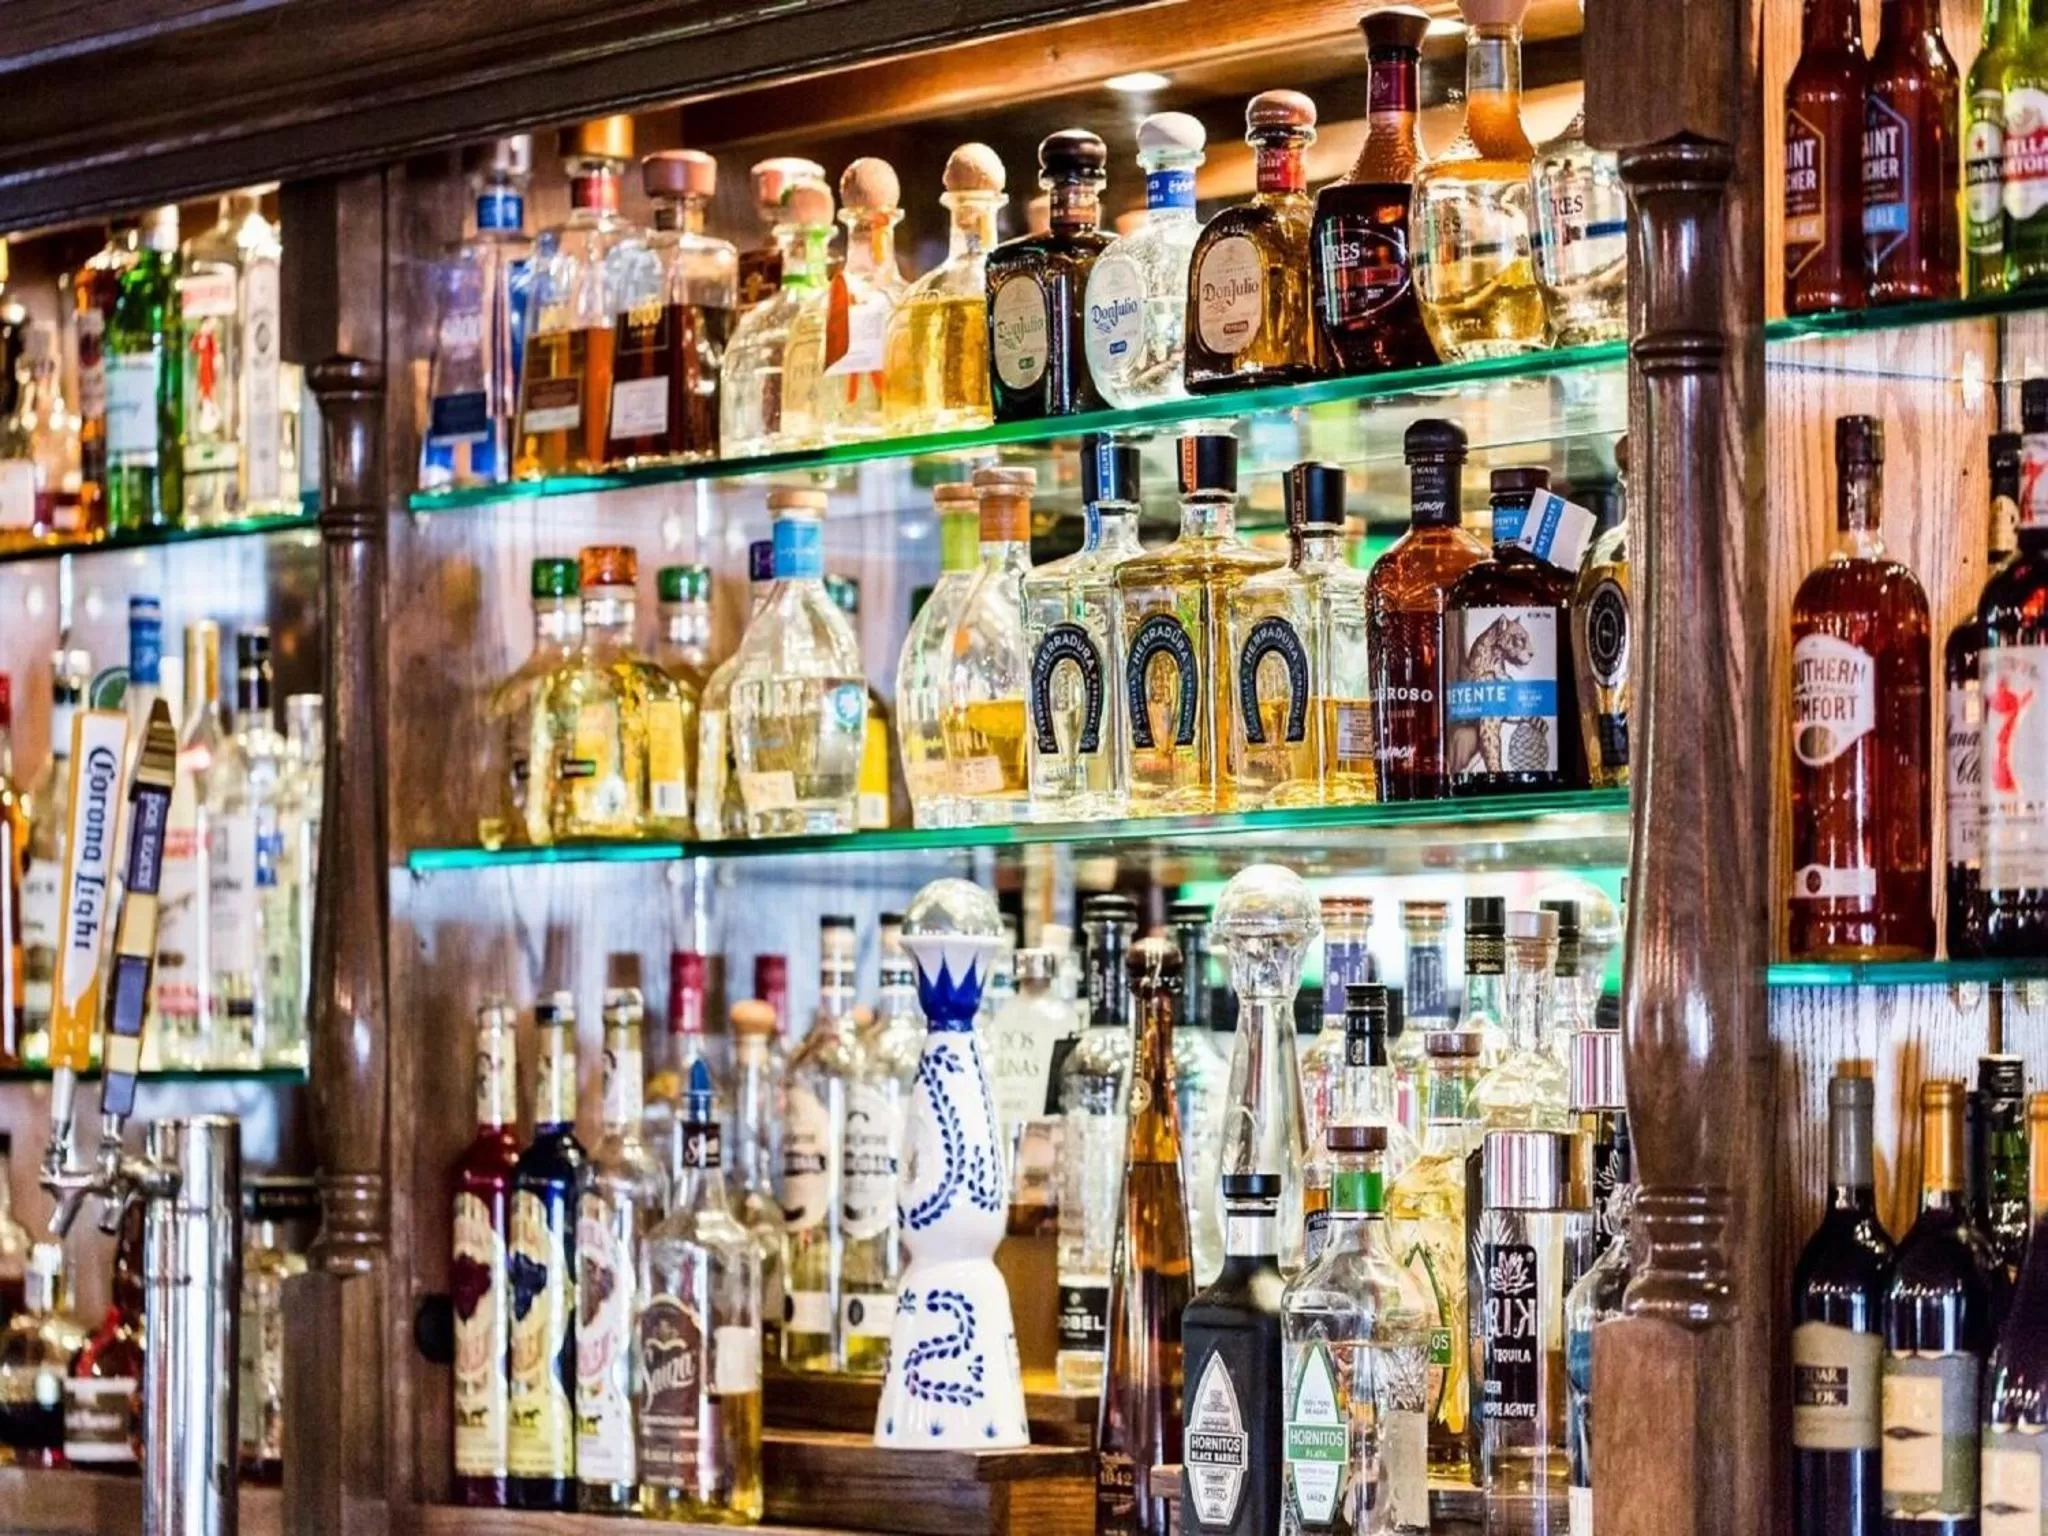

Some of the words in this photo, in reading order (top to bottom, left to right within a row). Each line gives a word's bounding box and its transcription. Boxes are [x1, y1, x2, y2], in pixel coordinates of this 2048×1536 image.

[1036, 633, 1095, 671] HERRADURA
[1133, 624, 1188, 665] HERRADURA
[1244, 626, 1299, 664] HERRADURA
[83, 746, 116, 862] Corona
[73, 871, 106, 950] Light
[1494, 1348, 1531, 1362] TEQUILA
[1191, 1434, 1241, 1453] HORNITOS
[1191, 1450, 1212, 1462] BLACK
[1213, 1452, 1241, 1464] BARREL
[1290, 1429, 1344, 1447] HORNITOS
